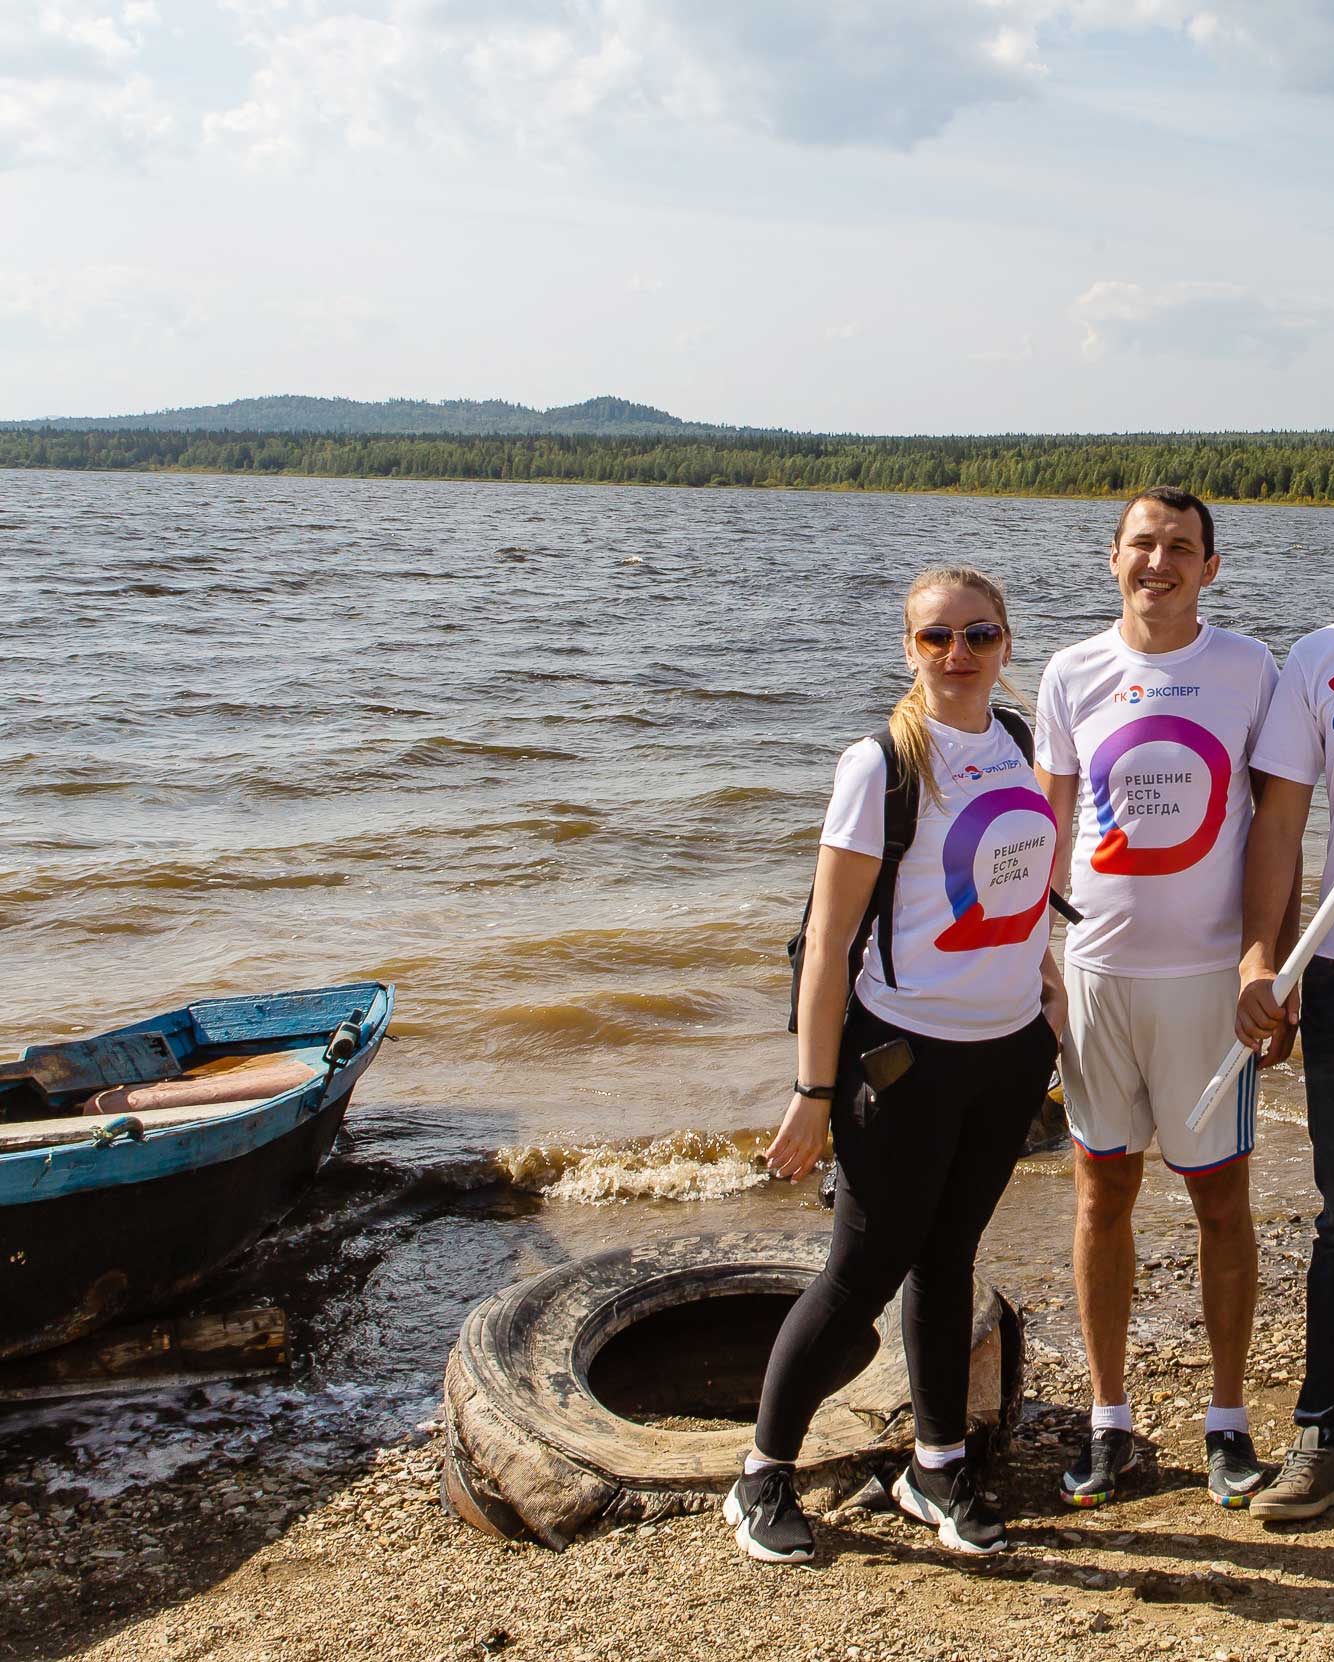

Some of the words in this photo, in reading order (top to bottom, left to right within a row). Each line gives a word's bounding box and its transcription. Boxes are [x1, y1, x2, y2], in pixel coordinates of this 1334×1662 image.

[1114, 692, 1128, 704] ГК
[1146, 686, 1201, 698] ЭКСПЕРТ
[1125, 772, 1192, 786] РЕШЕНИЕ
[1127, 789, 1161, 801] ЕСТЬ
[1128, 803, 1180, 816] ВСЕГДА
[994, 836, 1046, 860] РЕШЕНИЕ
[993, 857, 1019, 875] ЕСТЬ
